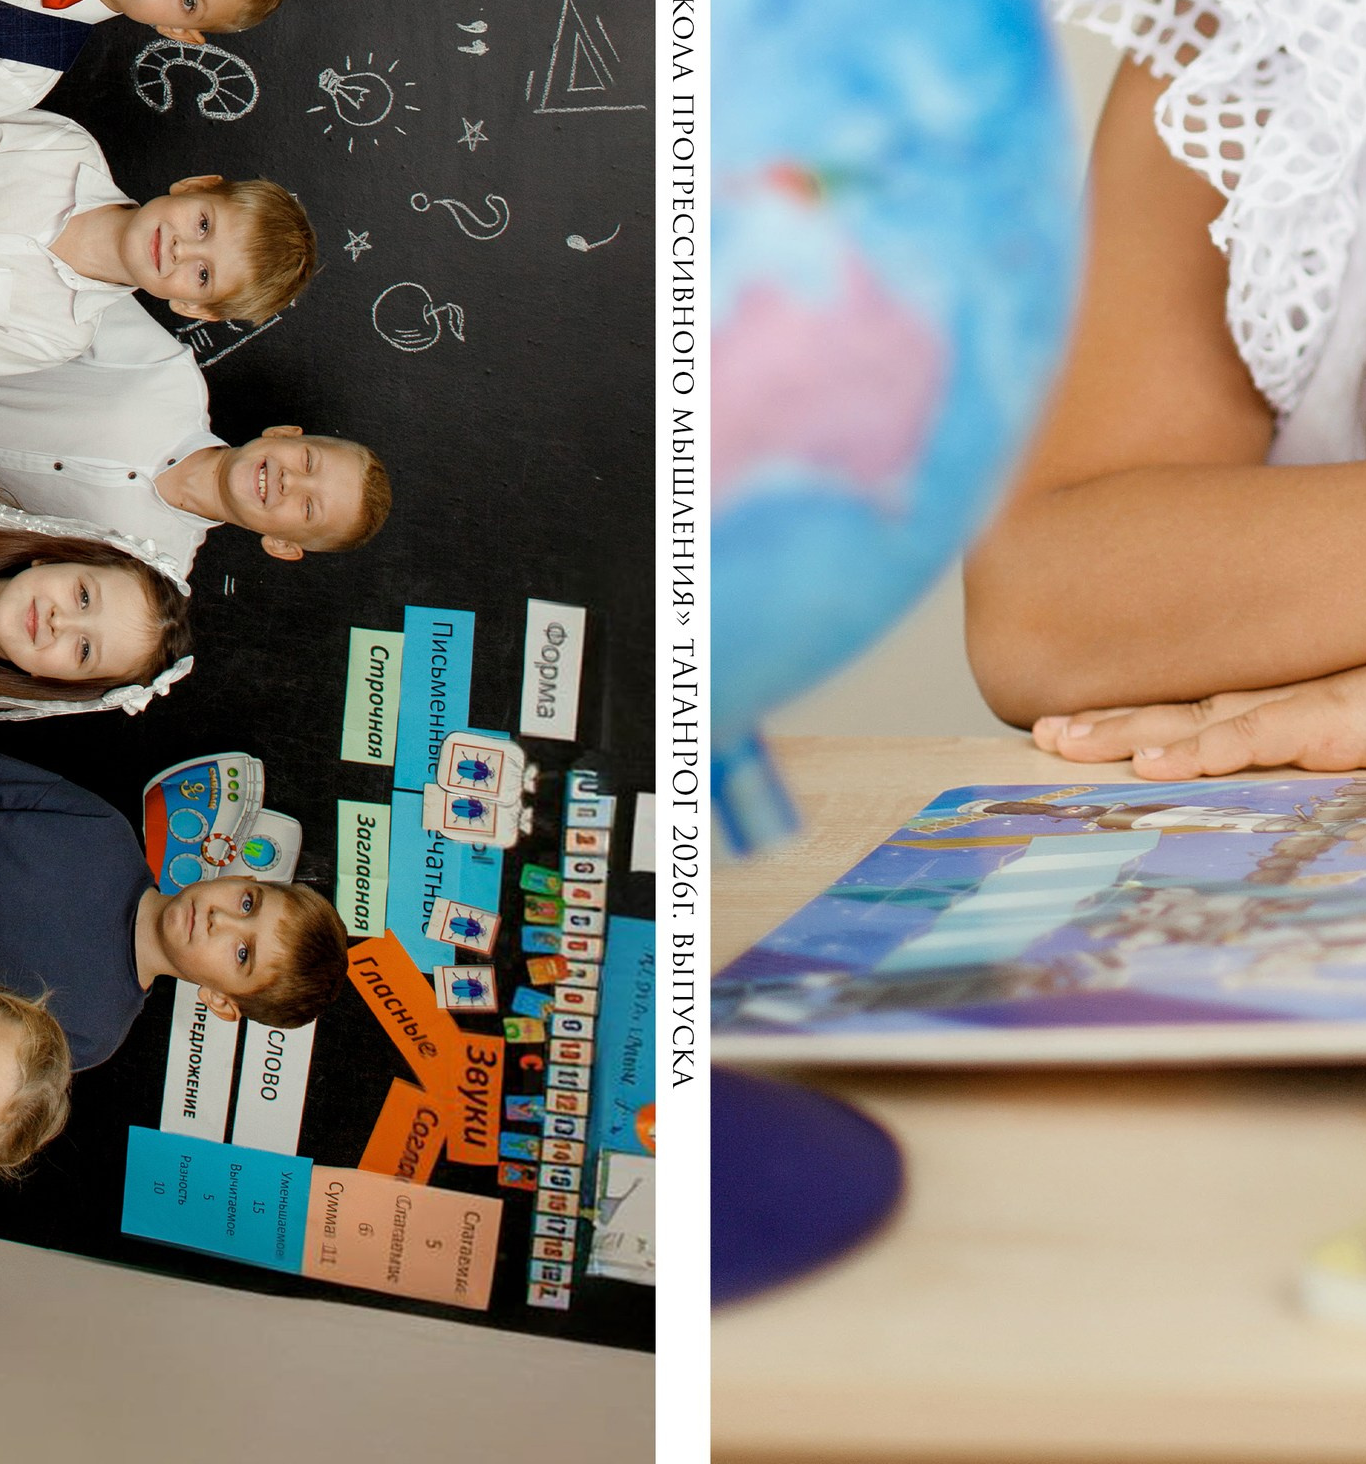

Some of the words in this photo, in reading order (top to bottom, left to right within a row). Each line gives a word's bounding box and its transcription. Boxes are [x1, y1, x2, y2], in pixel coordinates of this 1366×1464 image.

[366, 644, 390, 759] Строчная
[534, 622, 569, 720] Форма
[353, 813, 376, 932] Заглавная
[351, 955, 439, 1059] Гласные
[183, 1002, 208, 1119] ПРЕДЛОЖЕНИЕ
[260, 1029, 286, 1102] СЛОВО
[457, 1044, 497, 1148] Звуки
[153, 1180, 165, 1195] 10
[177, 1154, 192, 1206] Разность
[203, 1193, 215, 1201] 5
[225, 1163, 243, 1237] Вычитаемое
[252, 1200, 265, 1215] 15
[274, 1171, 294, 1260] Уменьшаемое
